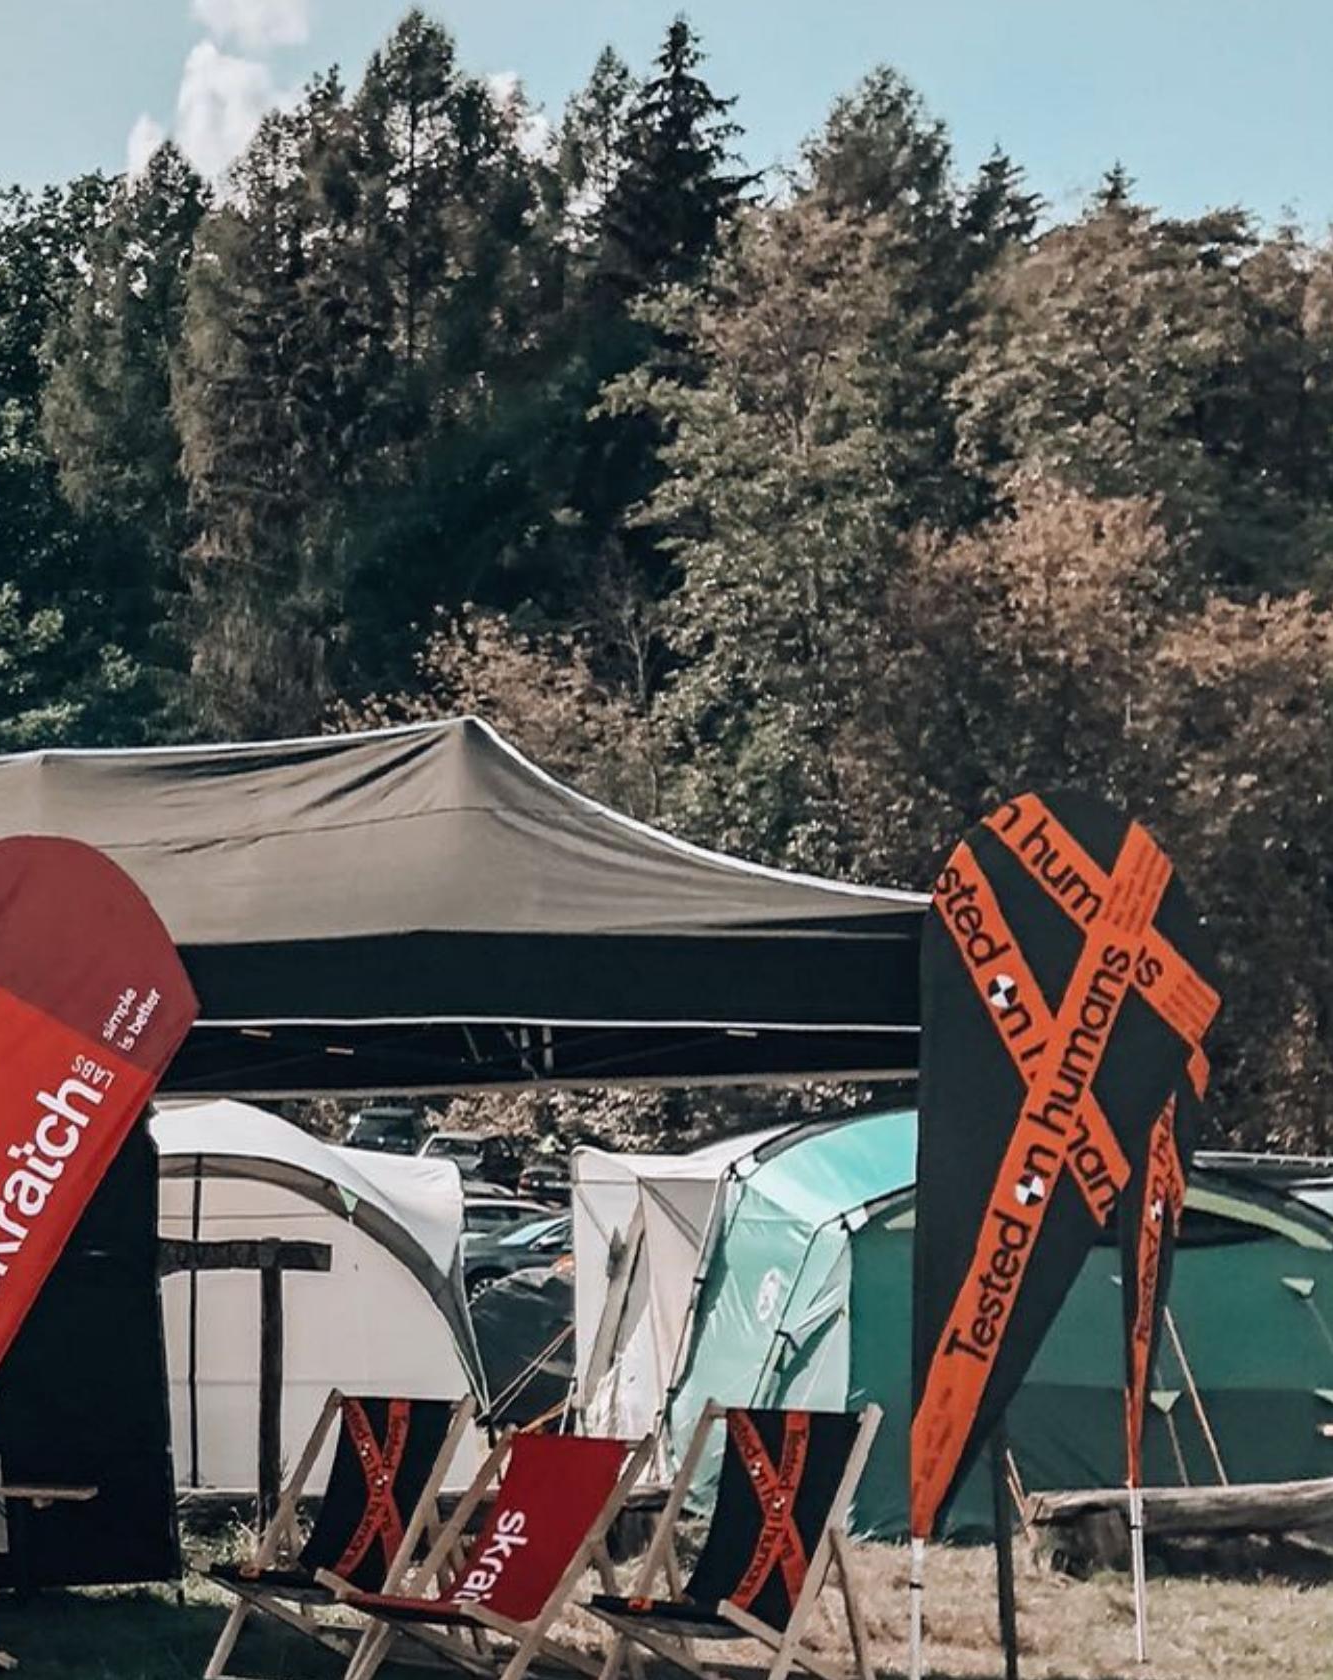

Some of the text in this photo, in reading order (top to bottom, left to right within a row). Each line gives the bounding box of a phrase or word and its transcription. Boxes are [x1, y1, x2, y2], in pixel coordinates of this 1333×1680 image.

[102, 987, 138, 1041] simple
[117, 987, 161, 1051] is better
[71, 1053, 116, 1091] LABS
[935, 1209, 1032, 1362] Tested
[1026, 945, 1132, 1137] humans
